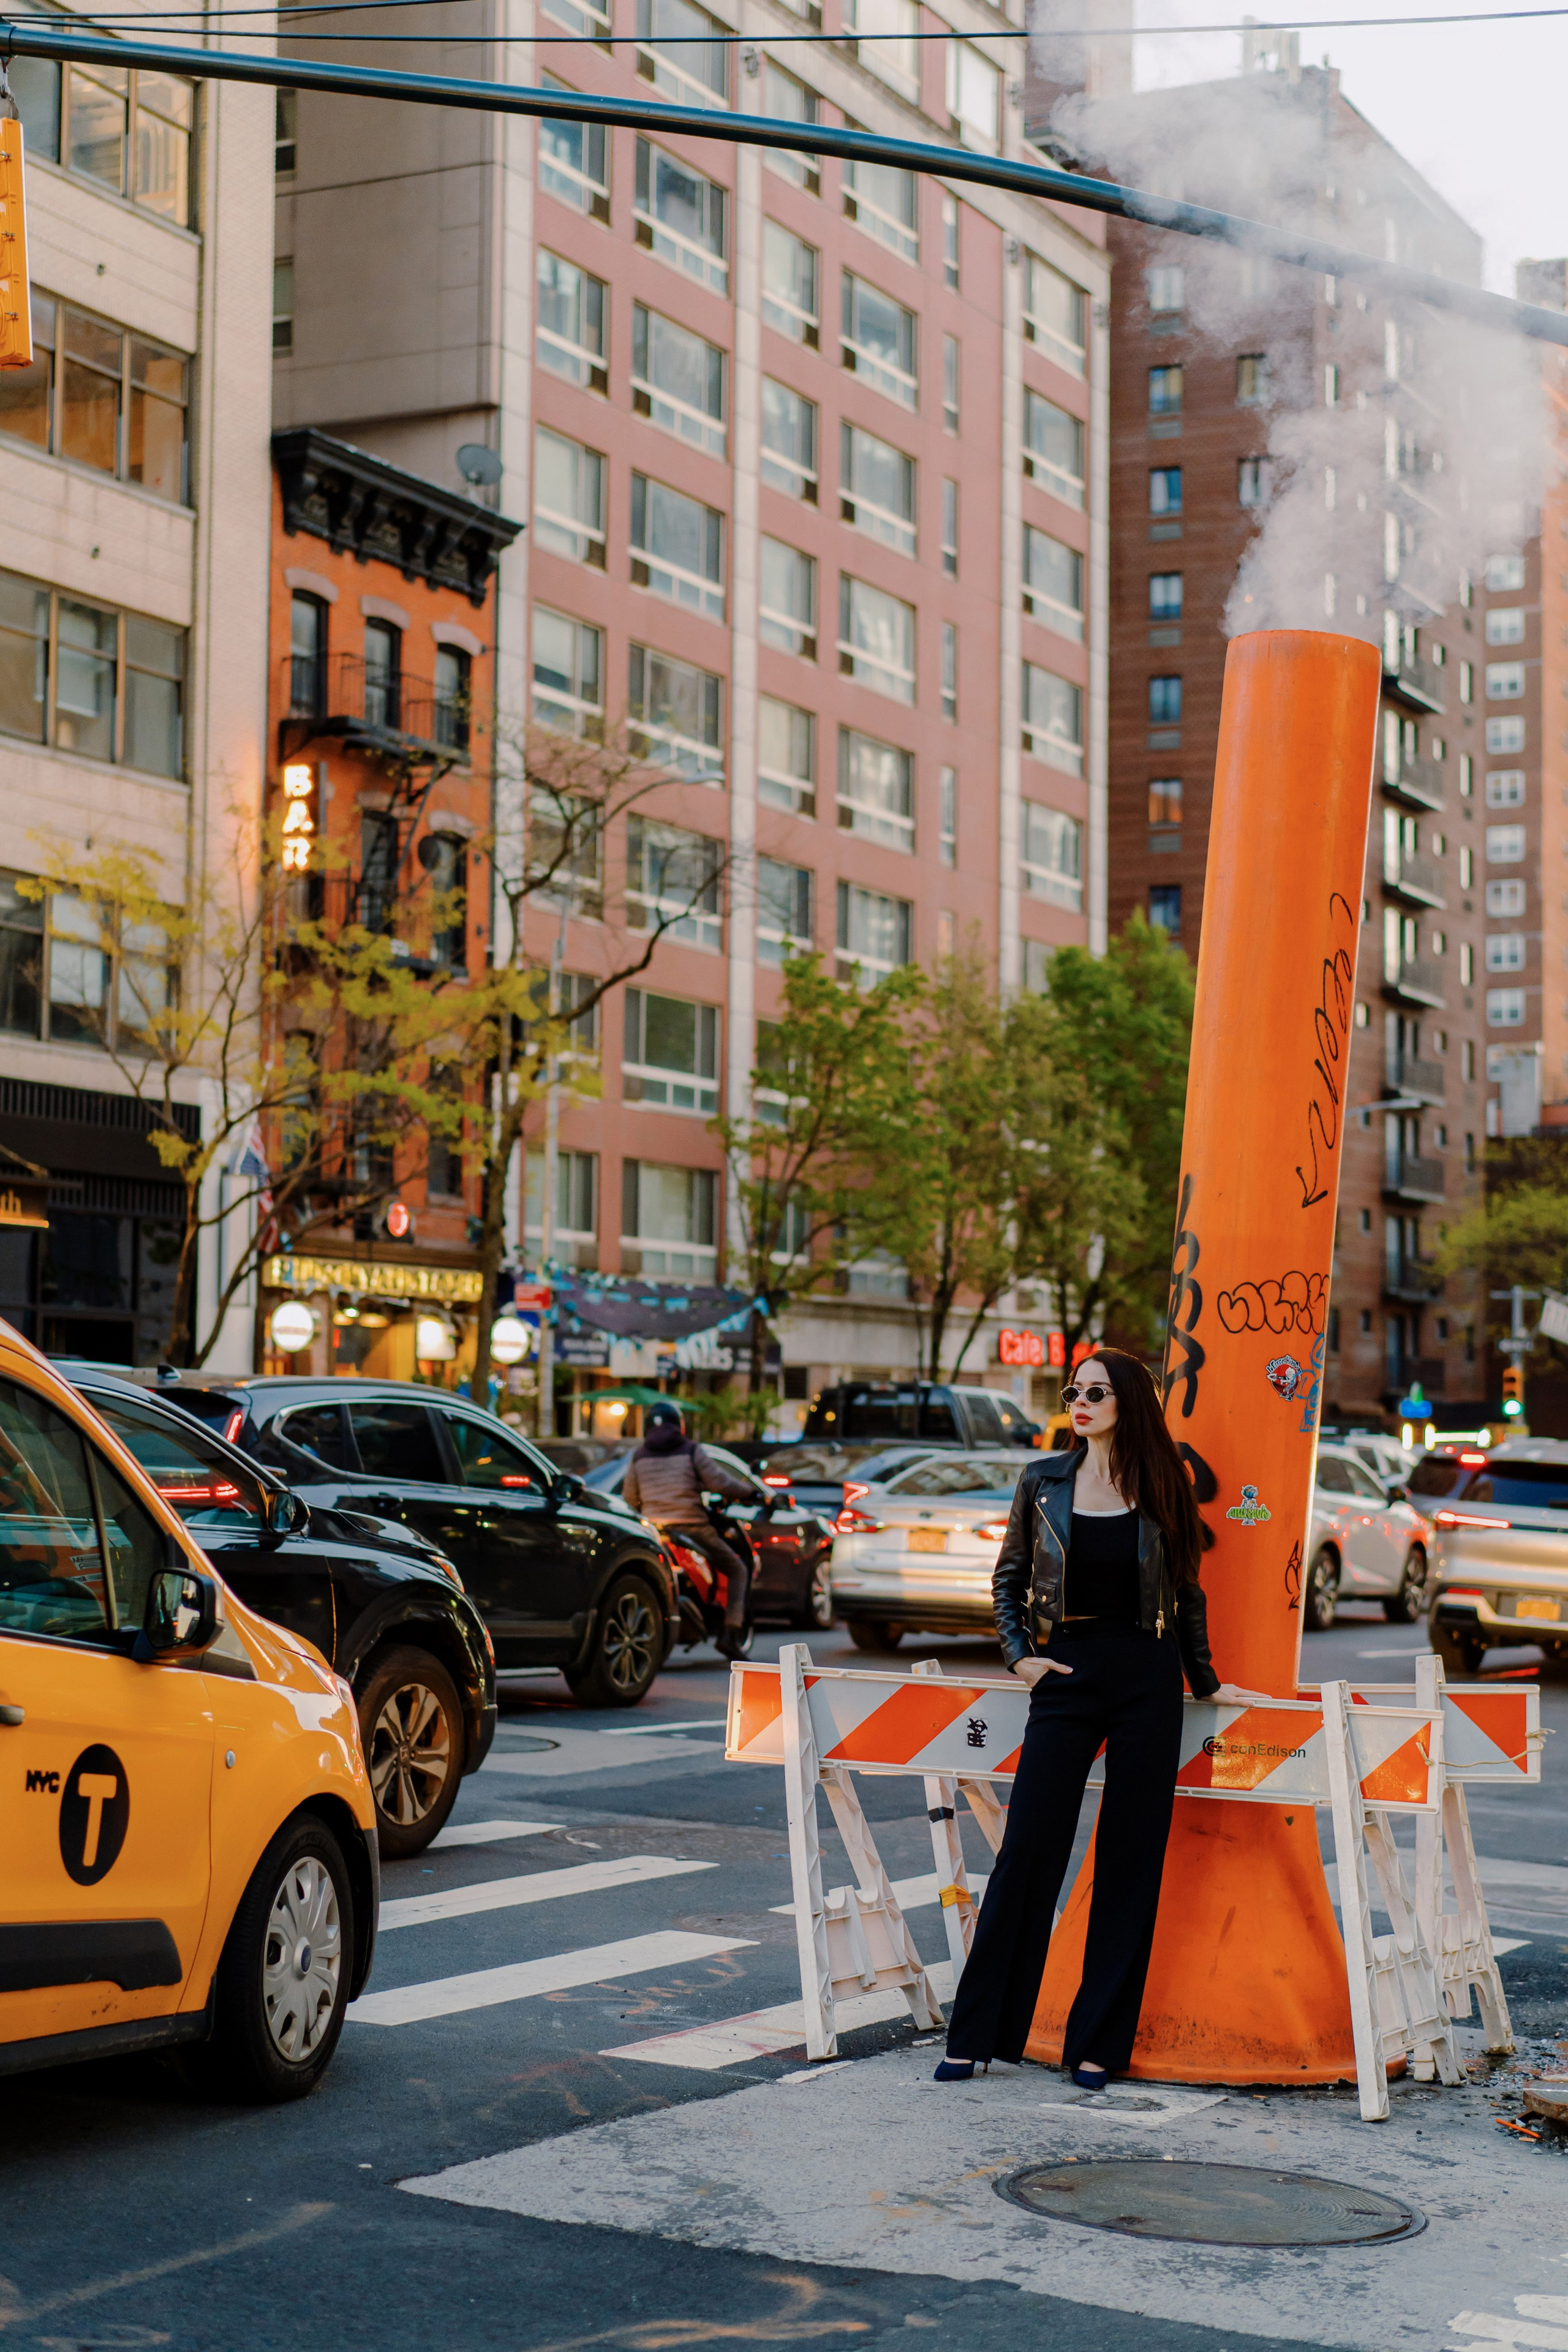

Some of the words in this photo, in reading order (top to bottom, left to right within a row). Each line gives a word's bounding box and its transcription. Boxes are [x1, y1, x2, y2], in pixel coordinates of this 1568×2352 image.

[282, 764, 313, 870] BAR
[1230, 1743, 1306, 1758] conEdison
[26, 1770, 60, 1793] NYC
[77, 1772, 118, 1866] T
